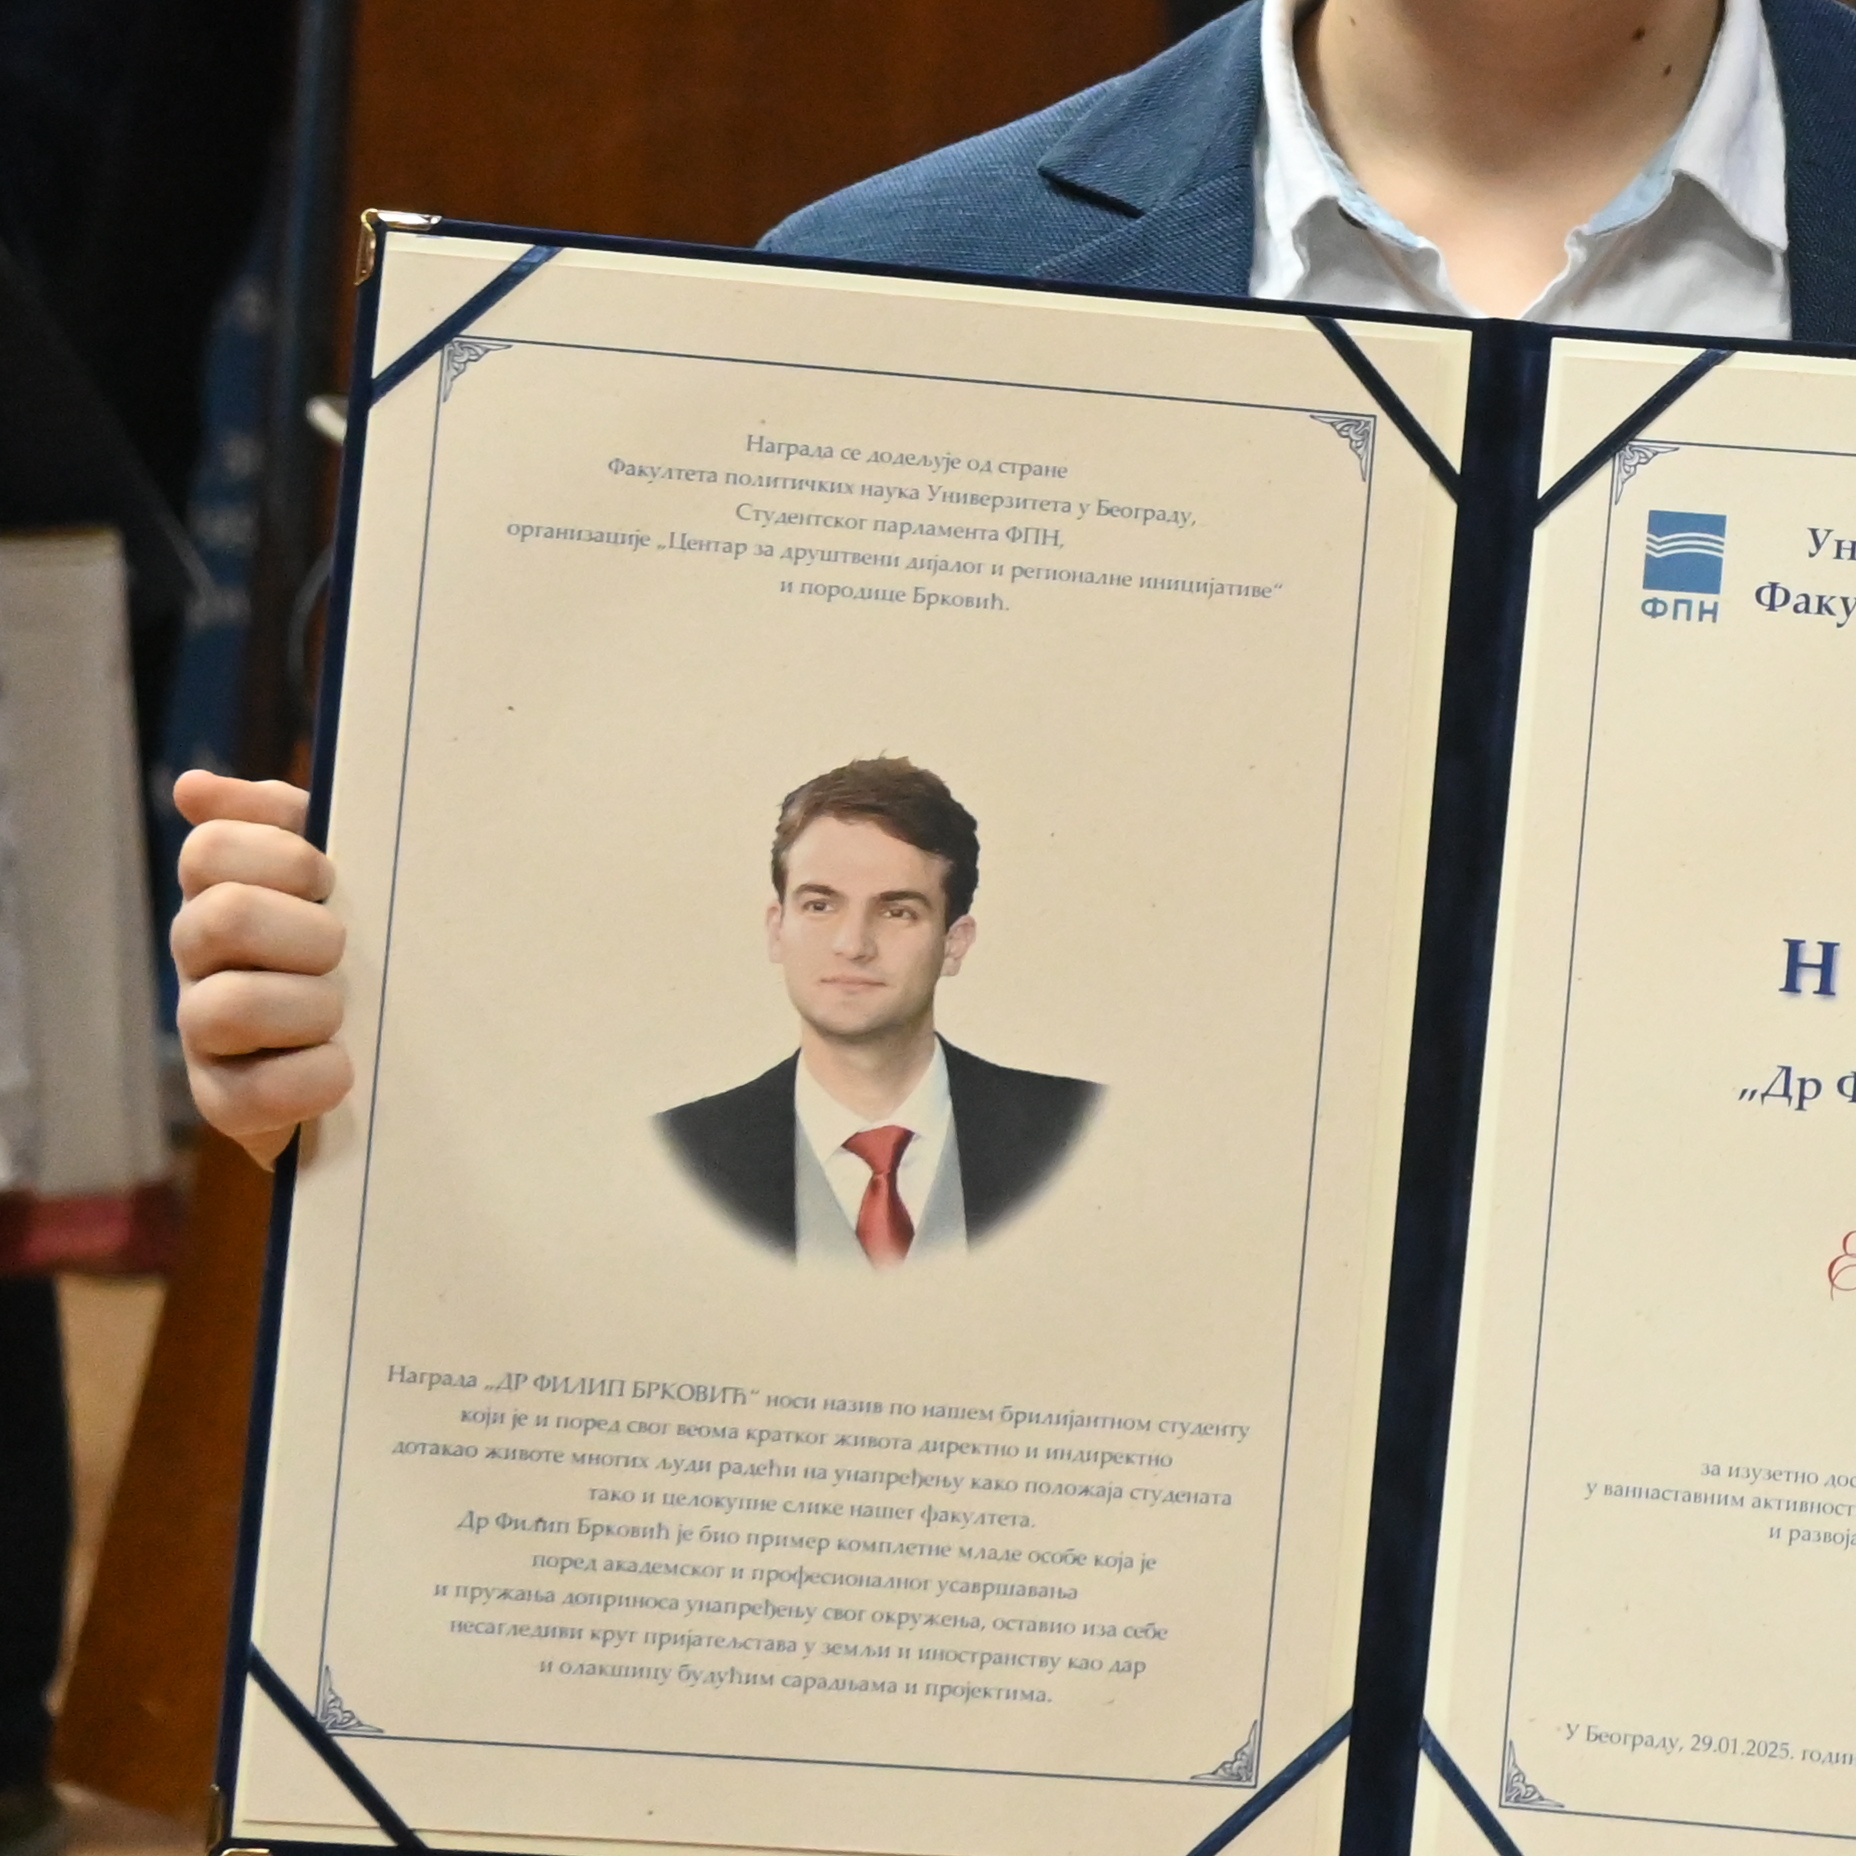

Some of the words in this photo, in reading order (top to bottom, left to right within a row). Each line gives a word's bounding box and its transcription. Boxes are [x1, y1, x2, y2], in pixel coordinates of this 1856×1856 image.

[745, 433, 834, 462] Награда
[839, 447, 862, 462] се
[865, 450, 962, 475] додељује
[966, 458, 993, 475] од
[997, 461, 1069, 482] стране
[607, 457, 718, 485] Факултета
[724, 471, 855, 495] политичких
[860, 483, 921, 505] наука
[927, 483, 1072, 514] Универзитета
[1075, 502, 1092, 521] у
[1095, 497, 1197, 530] Београду,
[735, 502, 869, 531] Студентског
[872, 519, 1000, 542] парламента
[1004, 525, 1065, 550] ФПН,
[752, 543, 775, 558] за
[779, 546, 901, 568] друштвени
[904, 553, 985, 577] дијалог
[990, 563, 1005, 577] и
[1010, 565, 1133, 588] регионалне
[779, 580, 794, 594] и
[798, 582, 907, 604] породице
[911, 585, 1010, 612] Брковић.
[1640, 596, 1719, 624] ФПН
[1737, 1064, 1823, 1112] „Др
[386, 1364, 478, 1392] Награда
[532, 1373, 627, 1398] ФИЛИП
[765, 1394, 817, 1411] носи
[822, 1397, 884, 1415] назив
[888, 1402, 917, 1417] по
[921, 1404, 995, 1422] нашем
[999, 1404, 1152, 1433] брилијантном
[1157, 1419, 1251, 1444] студенту
[459, 1406, 507, 1430] који
[510, 1407, 529, 1431] је
[533, 1414, 550, 1428] и
[555, 1415, 622, 1437] поред
[625, 1420, 672, 1436] свог
[676, 1423, 740, 1440] веома
[745, 1427, 829, 1449] кратког
[832, 1433, 913, 1451] живота
[916, 1439, 1020, 1460] директно
[1024, 1445, 1039, 1460] и
[390, 1440, 479, 1459] дотакао
[484, 1446, 566, 1464] животе
[654, 1456, 712, 1477] људи
[717, 1458, 797, 1481] радећи
[802, 1466, 828, 1481] на
[831, 1467, 966, 1495] унапређењу
[969, 1476, 1019, 1493] како
[1024, 1480, 1124, 1506] положаја
[1128, 1487, 1233, 1508] студената
[1583, 1481, 1598, 1501] у
[1603, 1483, 1745, 1508] ваннаставним
[1700, 1462, 1722, 1478] за
[1727, 1465, 1820, 1486] изузетно
[588, 1487, 636, 1504] тако
[640, 1491, 656, 1505] и
[781, 1499, 844, 1517] слике
[849, 1504, 915, 1521] нашег
[919, 1503, 1036, 1530] факултета.
[454, 1509, 490, 1536] Др
[576, 1516, 671, 1543] Брковић
[675, 1523, 695, 1547] је
[698, 1524, 741, 1545] био
[745, 1532, 831, 1557] пример
[836, 1537, 953, 1558] комплетне
[958, 1545, 1023, 1563] младе
[1027, 1547, 1088, 1567] особе
[1093, 1550, 1135, 1575] која
[1138, 1552, 1158, 1576] је
[1768, 1526, 1782, 1540] и
[531, 1554, 598, 1576] поред
[602, 1558, 726, 1579] академског
[730, 1566, 745, 1580] и
[750, 1564, 933, 1592] професионалног
[935, 1579, 1079, 1602] усавршавања
[432, 1583, 450, 1597] и
[453, 1584, 556, 1606] пружања
[561, 1591, 680, 1614] доприноса
[683, 1597, 818, 1626] унапређењу
[821, 1606, 867, 1623] свог
[870, 1610, 986, 1633] окружења,
[991, 1617, 1077, 1636] оставио
[1081, 1623, 1118, 1638] иза
[1122, 1621, 1169, 1642] себе
[589, 1628, 639, 1649] круг
[801, 1640, 817, 1661] у
[820, 1641, 892, 1659] земљи
[897, 1646, 912, 1661] и
[917, 1647, 1063, 1675] иностранству
[1067, 1656, 1104, 1672] као
[1107, 1659, 1147, 1681] дар
[538, 1660, 554, 1674] и
[677, 1663, 775, 1690] будућим
[780, 1674, 898, 1696] сарадњама
[904, 1682, 918, 1695] и
[924, 1680, 1053, 1705] пројектима.
[1565, 1722, 1581, 1742] У
[1585, 1724, 1684, 1756] Београду,
[1689, 1733, 1795, 1761] 29.01.2025.
